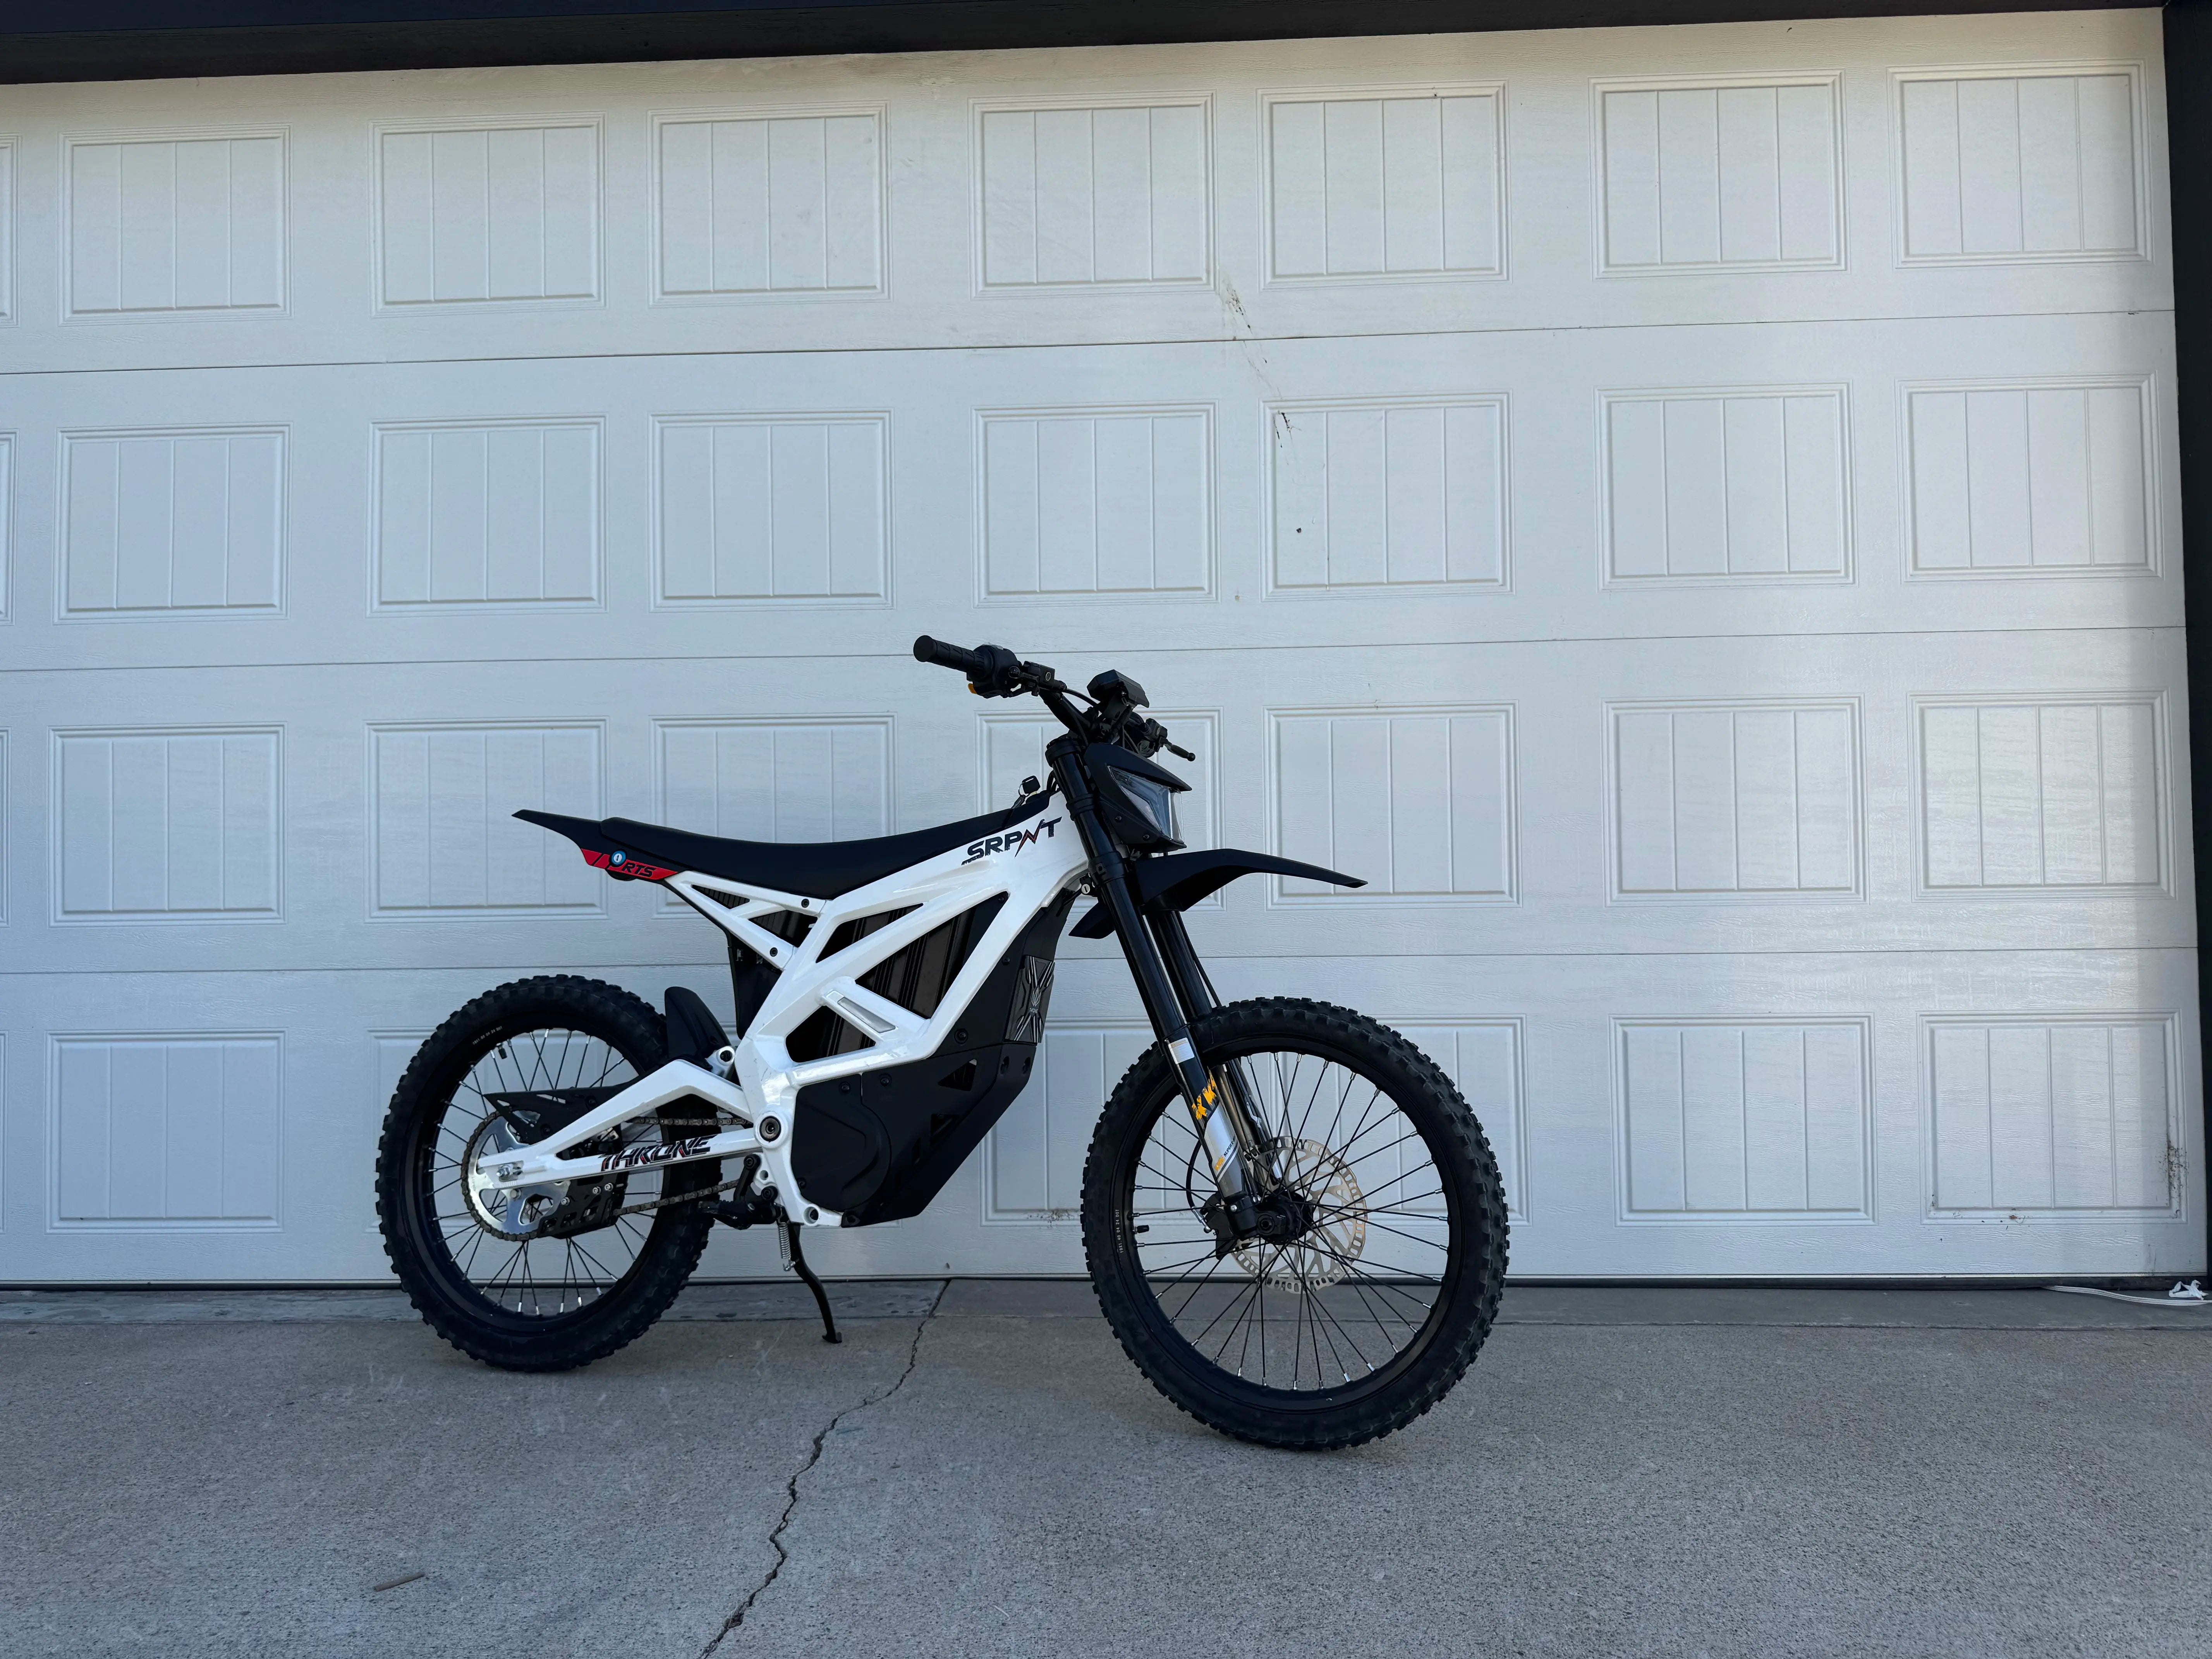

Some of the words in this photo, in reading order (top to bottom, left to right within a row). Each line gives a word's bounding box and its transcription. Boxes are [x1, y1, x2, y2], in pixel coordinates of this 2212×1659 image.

[961, 816, 1062, 866] SRPNT
[622, 862, 656, 877] RTS
[599, 1134, 718, 1171] THRONE
